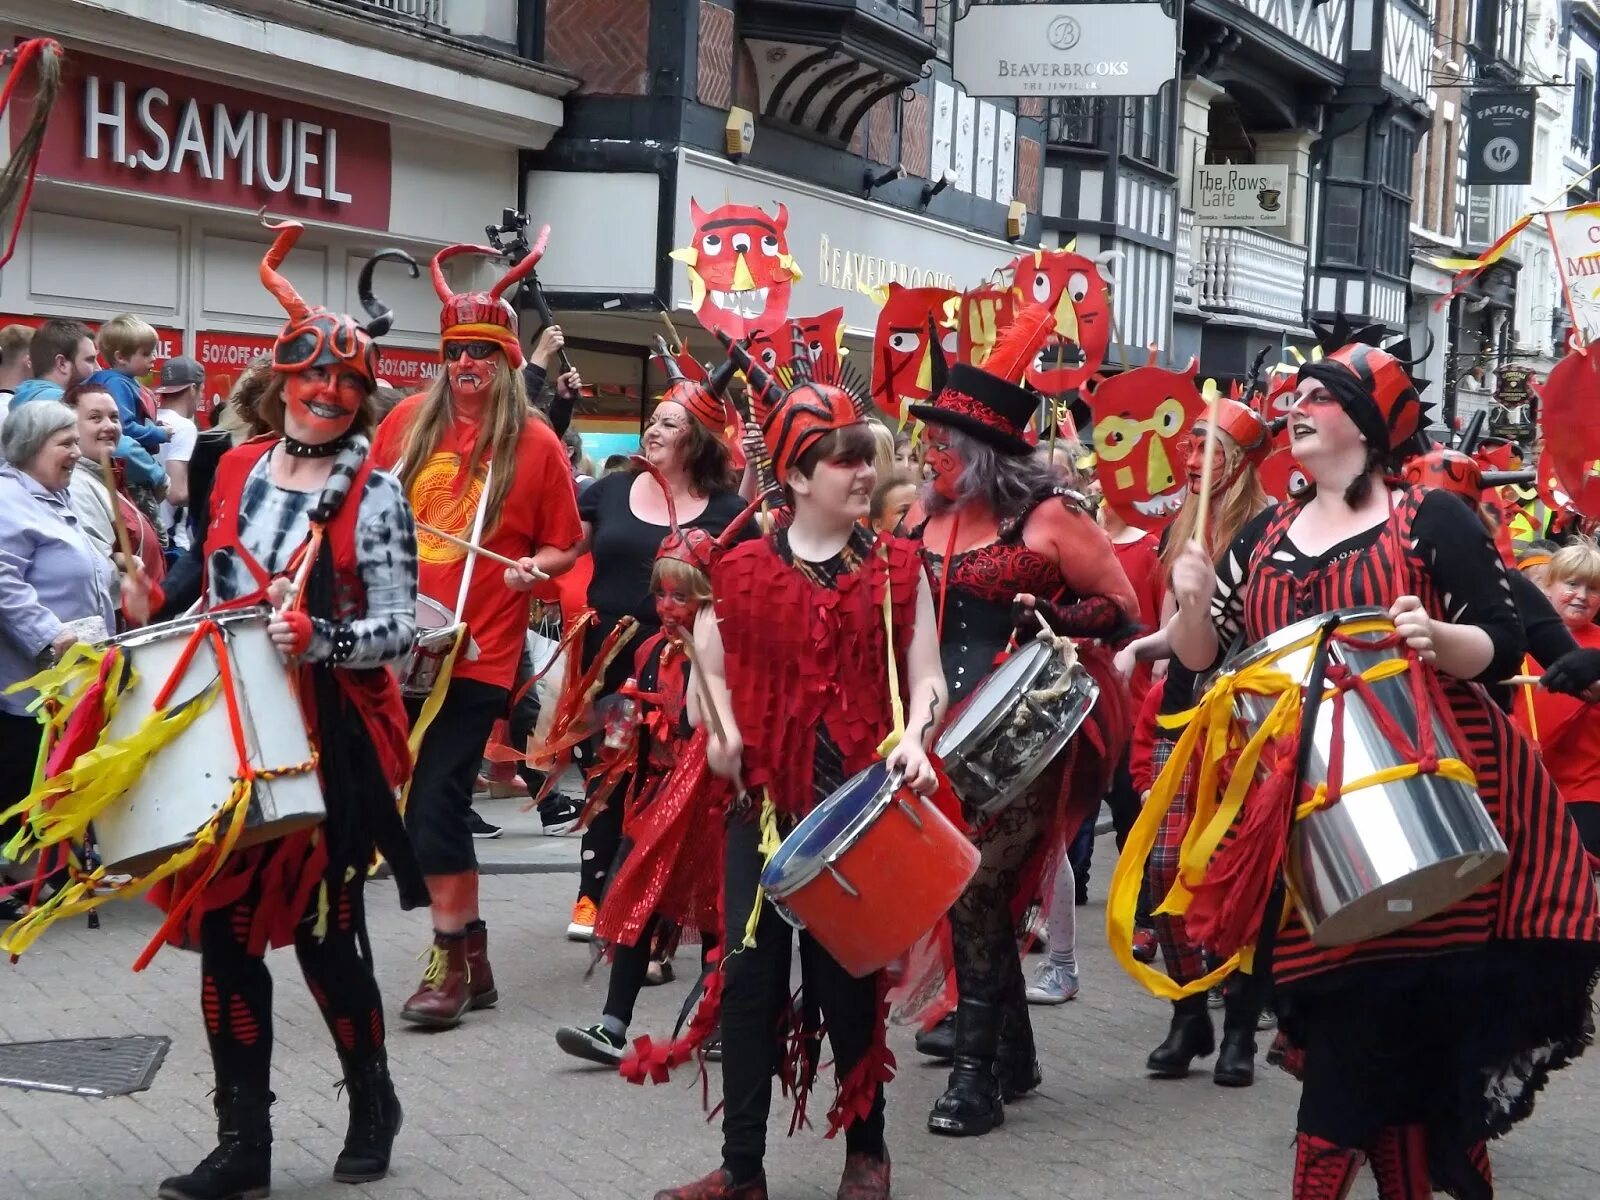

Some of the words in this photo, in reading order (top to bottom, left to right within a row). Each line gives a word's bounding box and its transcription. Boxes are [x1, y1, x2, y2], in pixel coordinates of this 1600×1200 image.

[998, 60, 1129, 77] BEAVERBROOKS
[1476, 105, 1531, 119] FATFACE
[1198, 170, 1222, 190] The
[1228, 170, 1267, 190] Rows
[1202, 186, 1235, 207] Café
[151, 340, 173, 360] ALE
